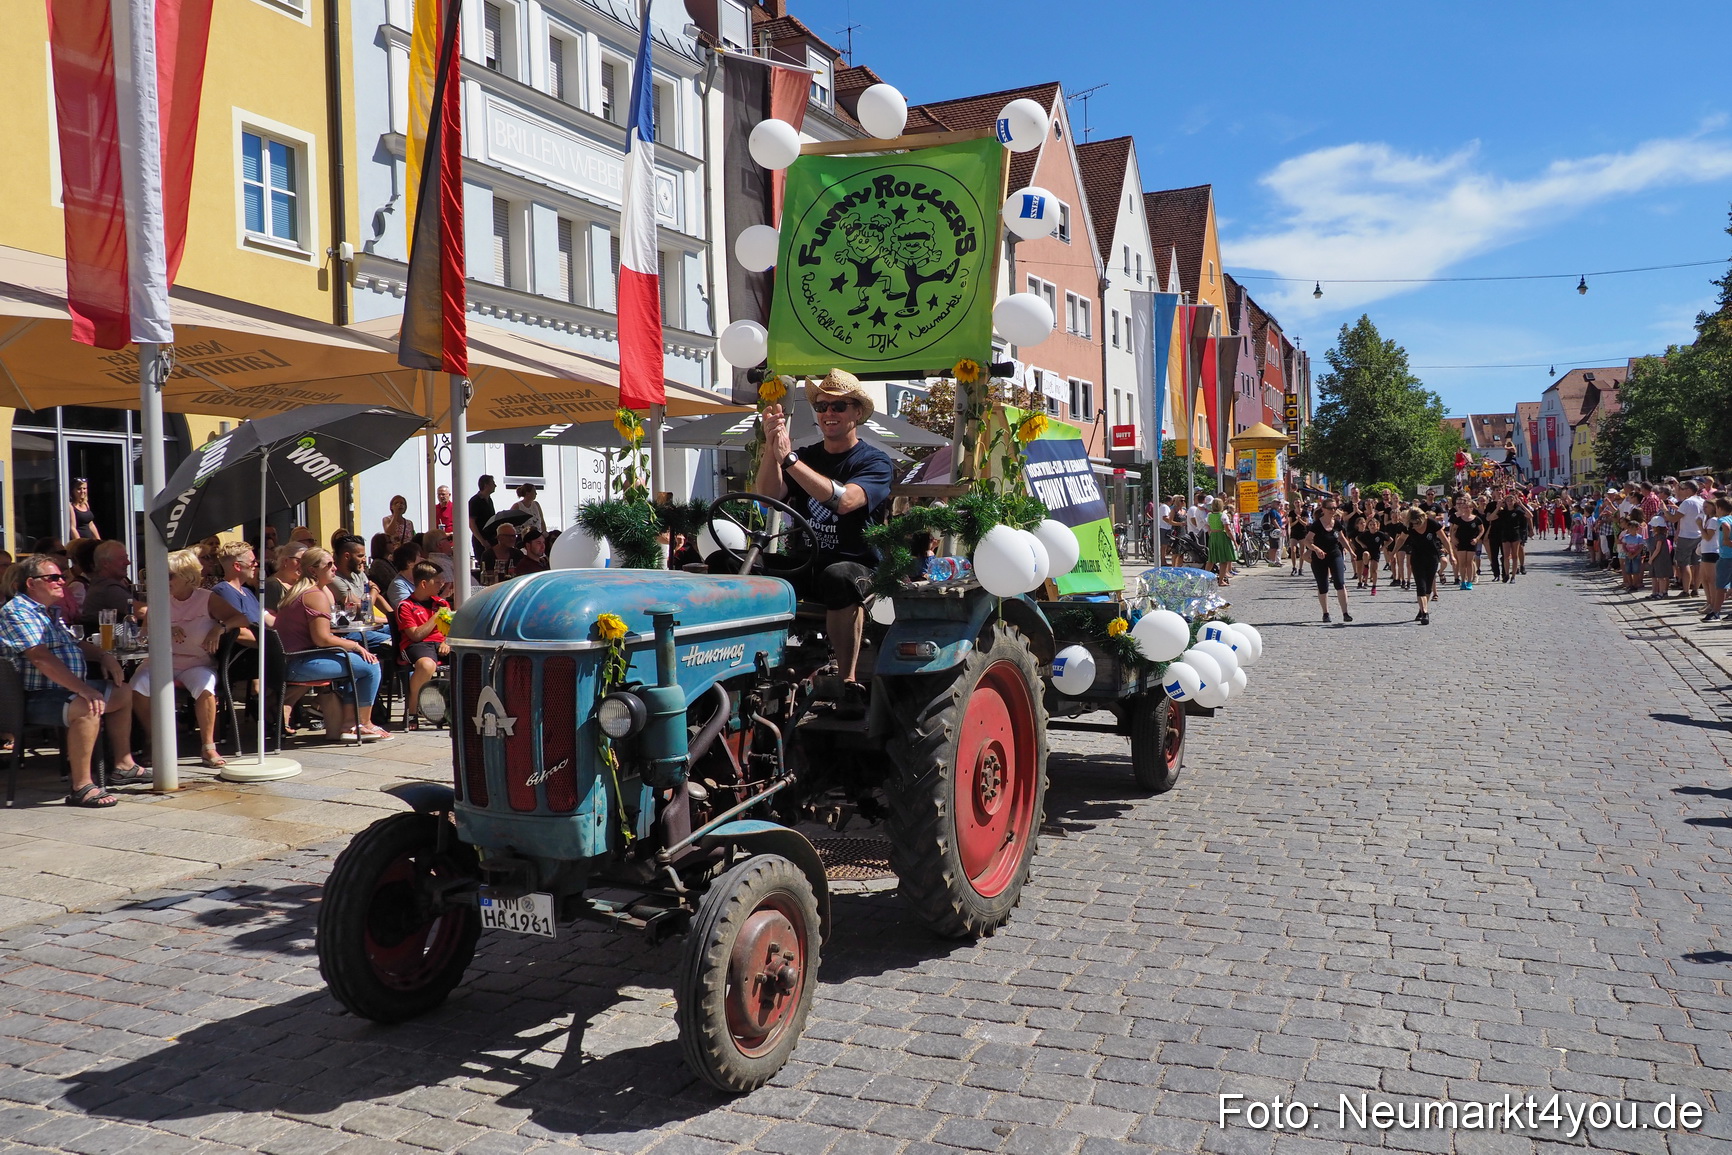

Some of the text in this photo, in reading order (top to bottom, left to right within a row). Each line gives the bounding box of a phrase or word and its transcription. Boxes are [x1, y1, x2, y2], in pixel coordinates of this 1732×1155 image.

[999, 119, 1009, 143] ZEISS
[494, 118, 565, 170] BRILLEN
[1030, 194, 1040, 219] ZEISS
[867, 333, 899, 353] DJK
[908, 294, 963, 340] Neumarkt
[1115, 431, 1131, 439] WITT
[1285, 395, 1298, 457] HOTEL
[592, 458, 605, 474] 30
[581, 477, 602, 493] Bang
[1033, 476, 1069, 511] FUNNY
[681, 643, 745, 667] Hanomag
[497, 899, 519, 911] NM
